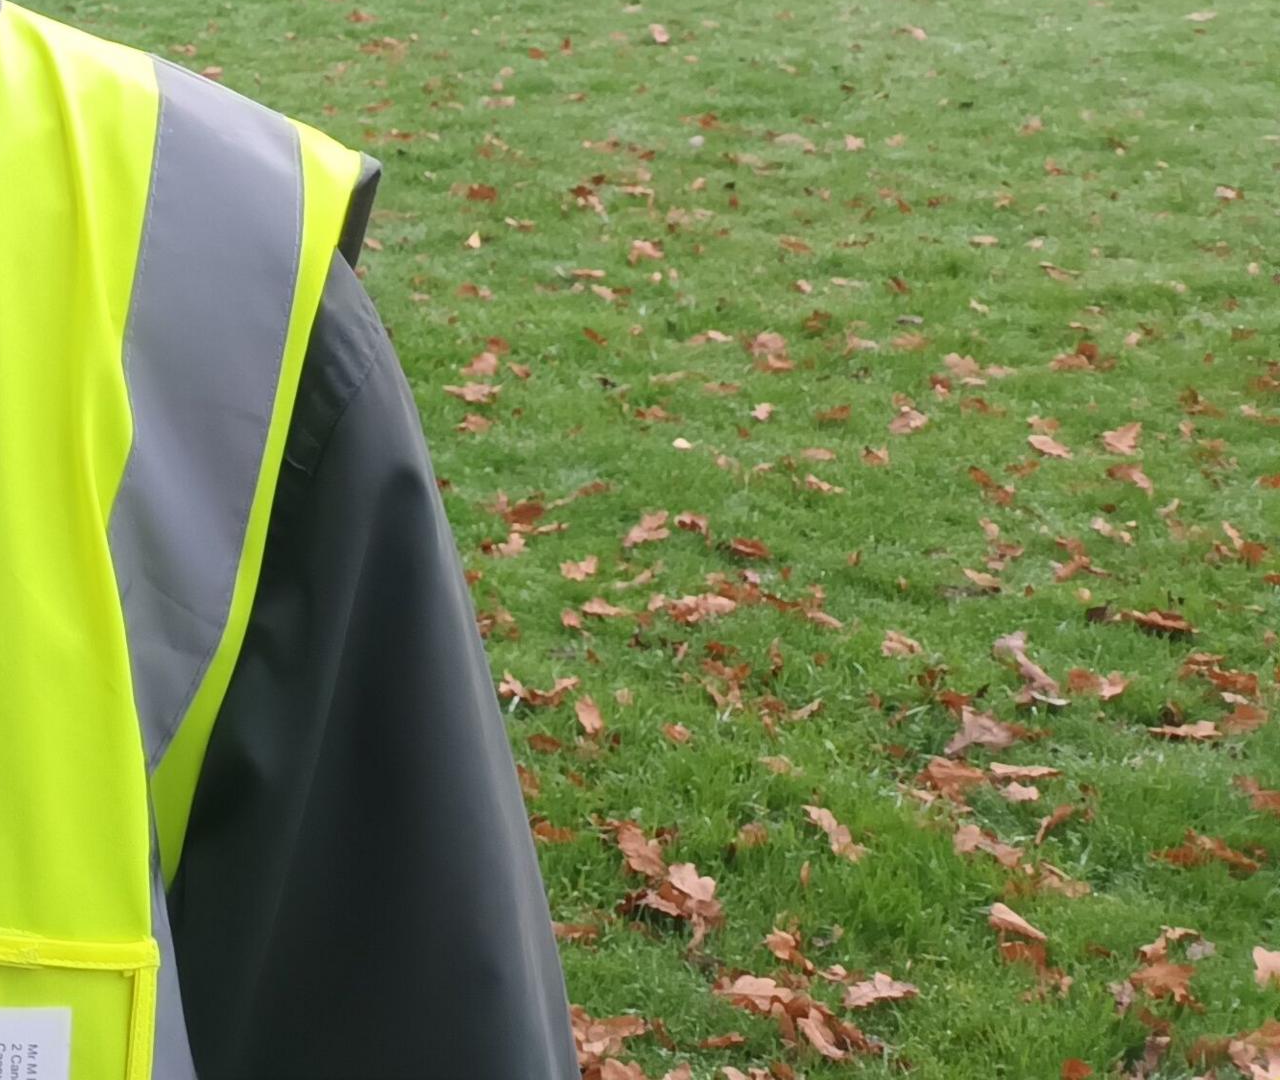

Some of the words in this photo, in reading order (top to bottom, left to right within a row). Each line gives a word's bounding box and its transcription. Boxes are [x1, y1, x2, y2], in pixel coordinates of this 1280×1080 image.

[11, 1043, 23, 1051] 2
[27, 1043, 38, 1060] Mr
[26, 1063, 38, 1075] M
